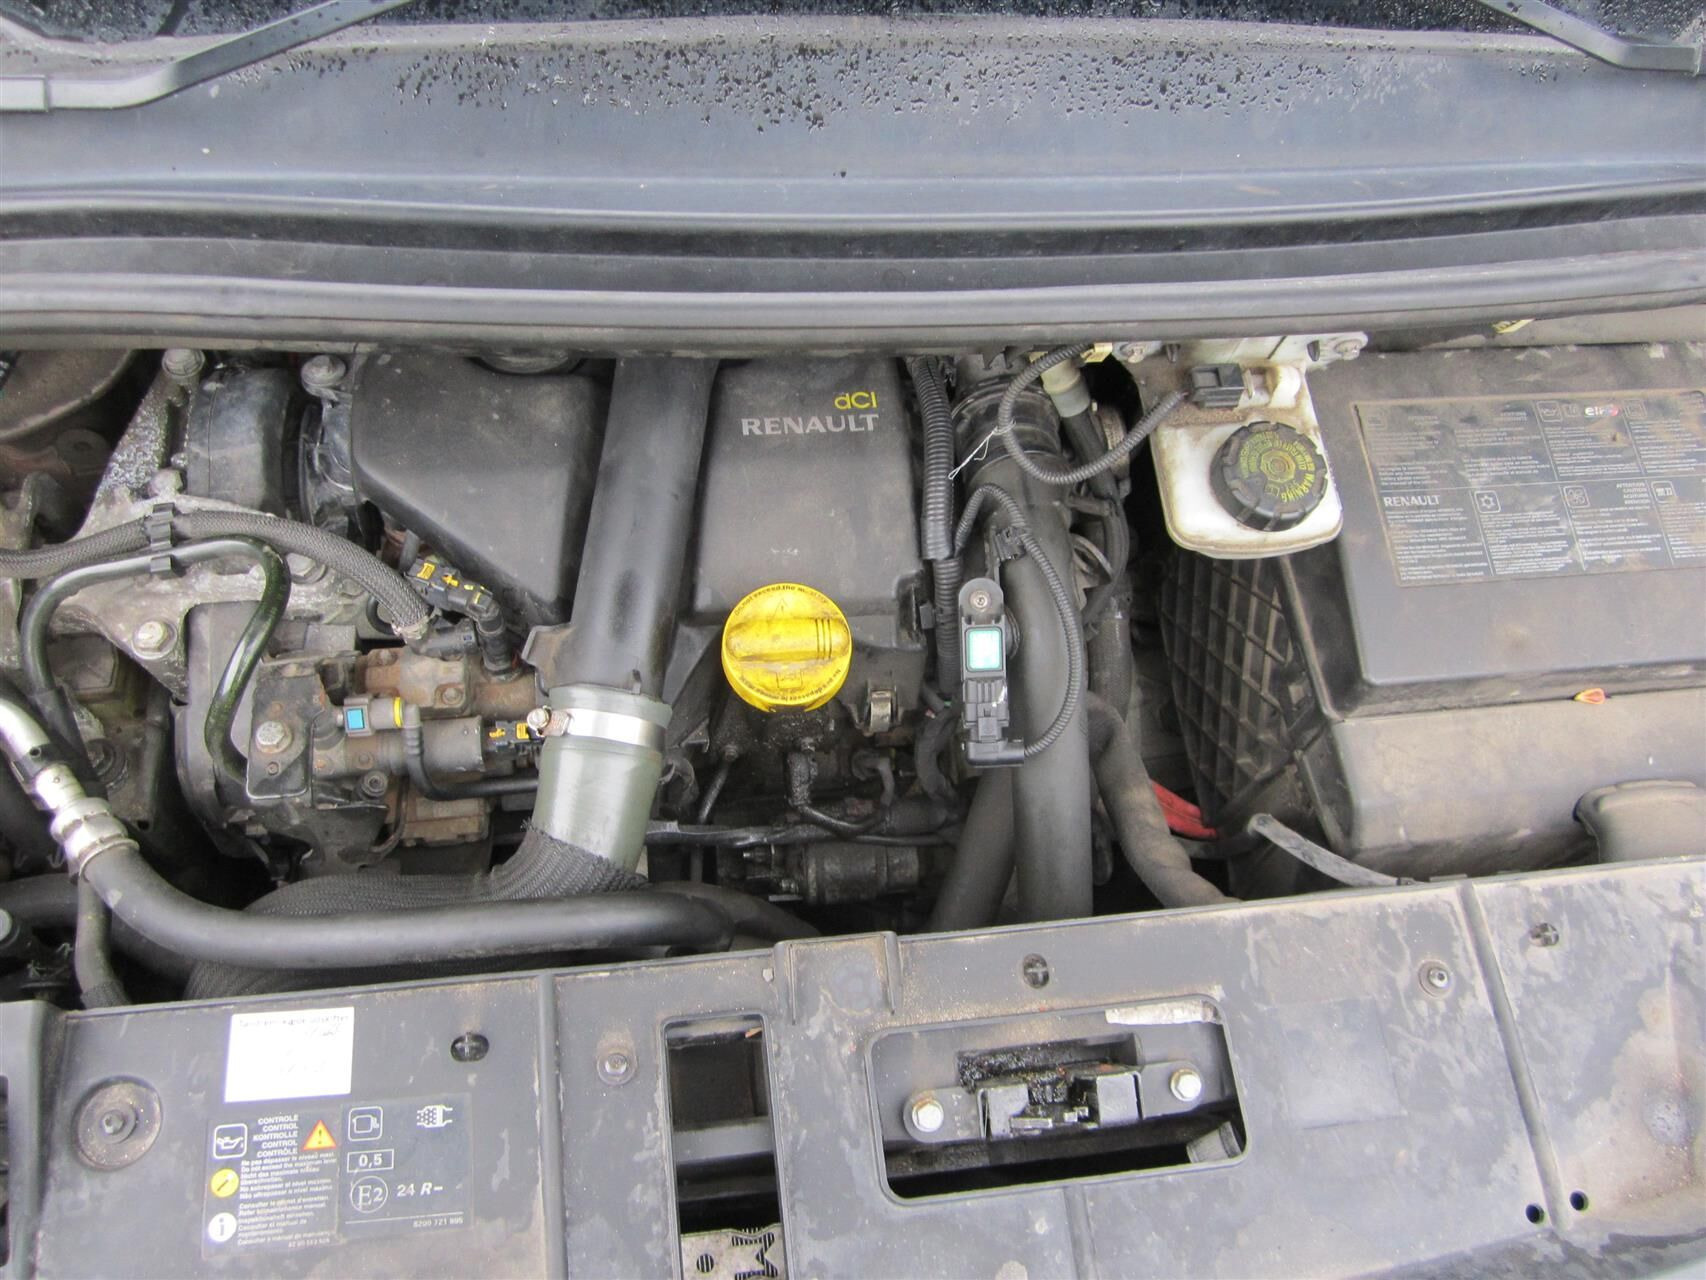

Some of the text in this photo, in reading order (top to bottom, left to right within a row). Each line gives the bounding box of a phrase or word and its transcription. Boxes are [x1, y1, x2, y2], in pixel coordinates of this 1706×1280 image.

[741, 413, 879, 436] RENAULT
[1383, 495, 1440, 507] RENAULT
[262, 1122, 299, 1132] CONTROL
[253, 1130, 298, 1141] KONTROLLE
[261, 1139, 298, 1149] CONTROL
[358, 1153, 382, 1169] 0,5
[357, 1184, 384, 1207] E2
[397, 1183, 416, 1197] 24
